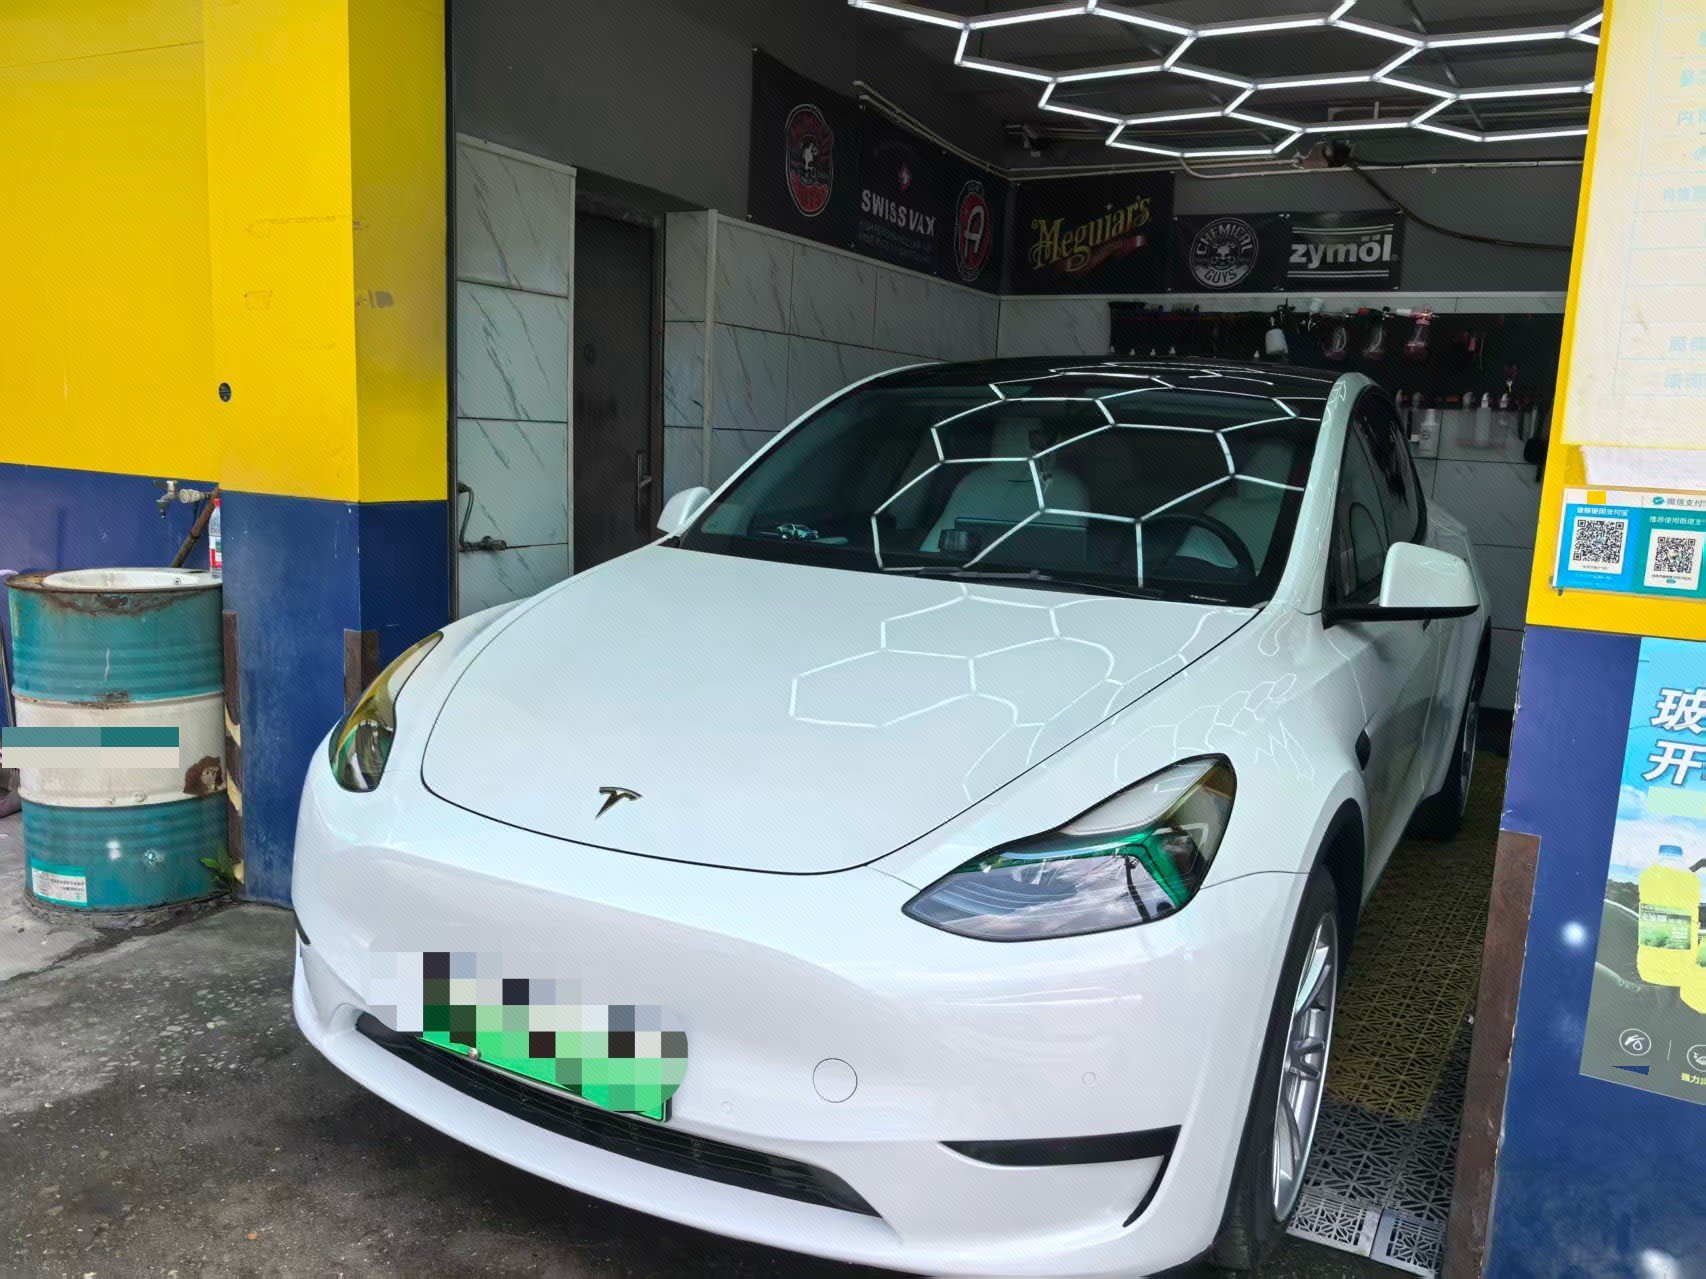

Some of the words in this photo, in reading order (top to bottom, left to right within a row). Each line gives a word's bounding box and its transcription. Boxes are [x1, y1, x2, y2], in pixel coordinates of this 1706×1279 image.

[861, 189, 937, 238] SWISSVAX
[1028, 195, 1152, 273] Meguiar's
[1195, 223, 1255, 256] CHEMICAL
[1289, 234, 1393, 270] zymöl
[1203, 268, 1238, 285] GUYS
